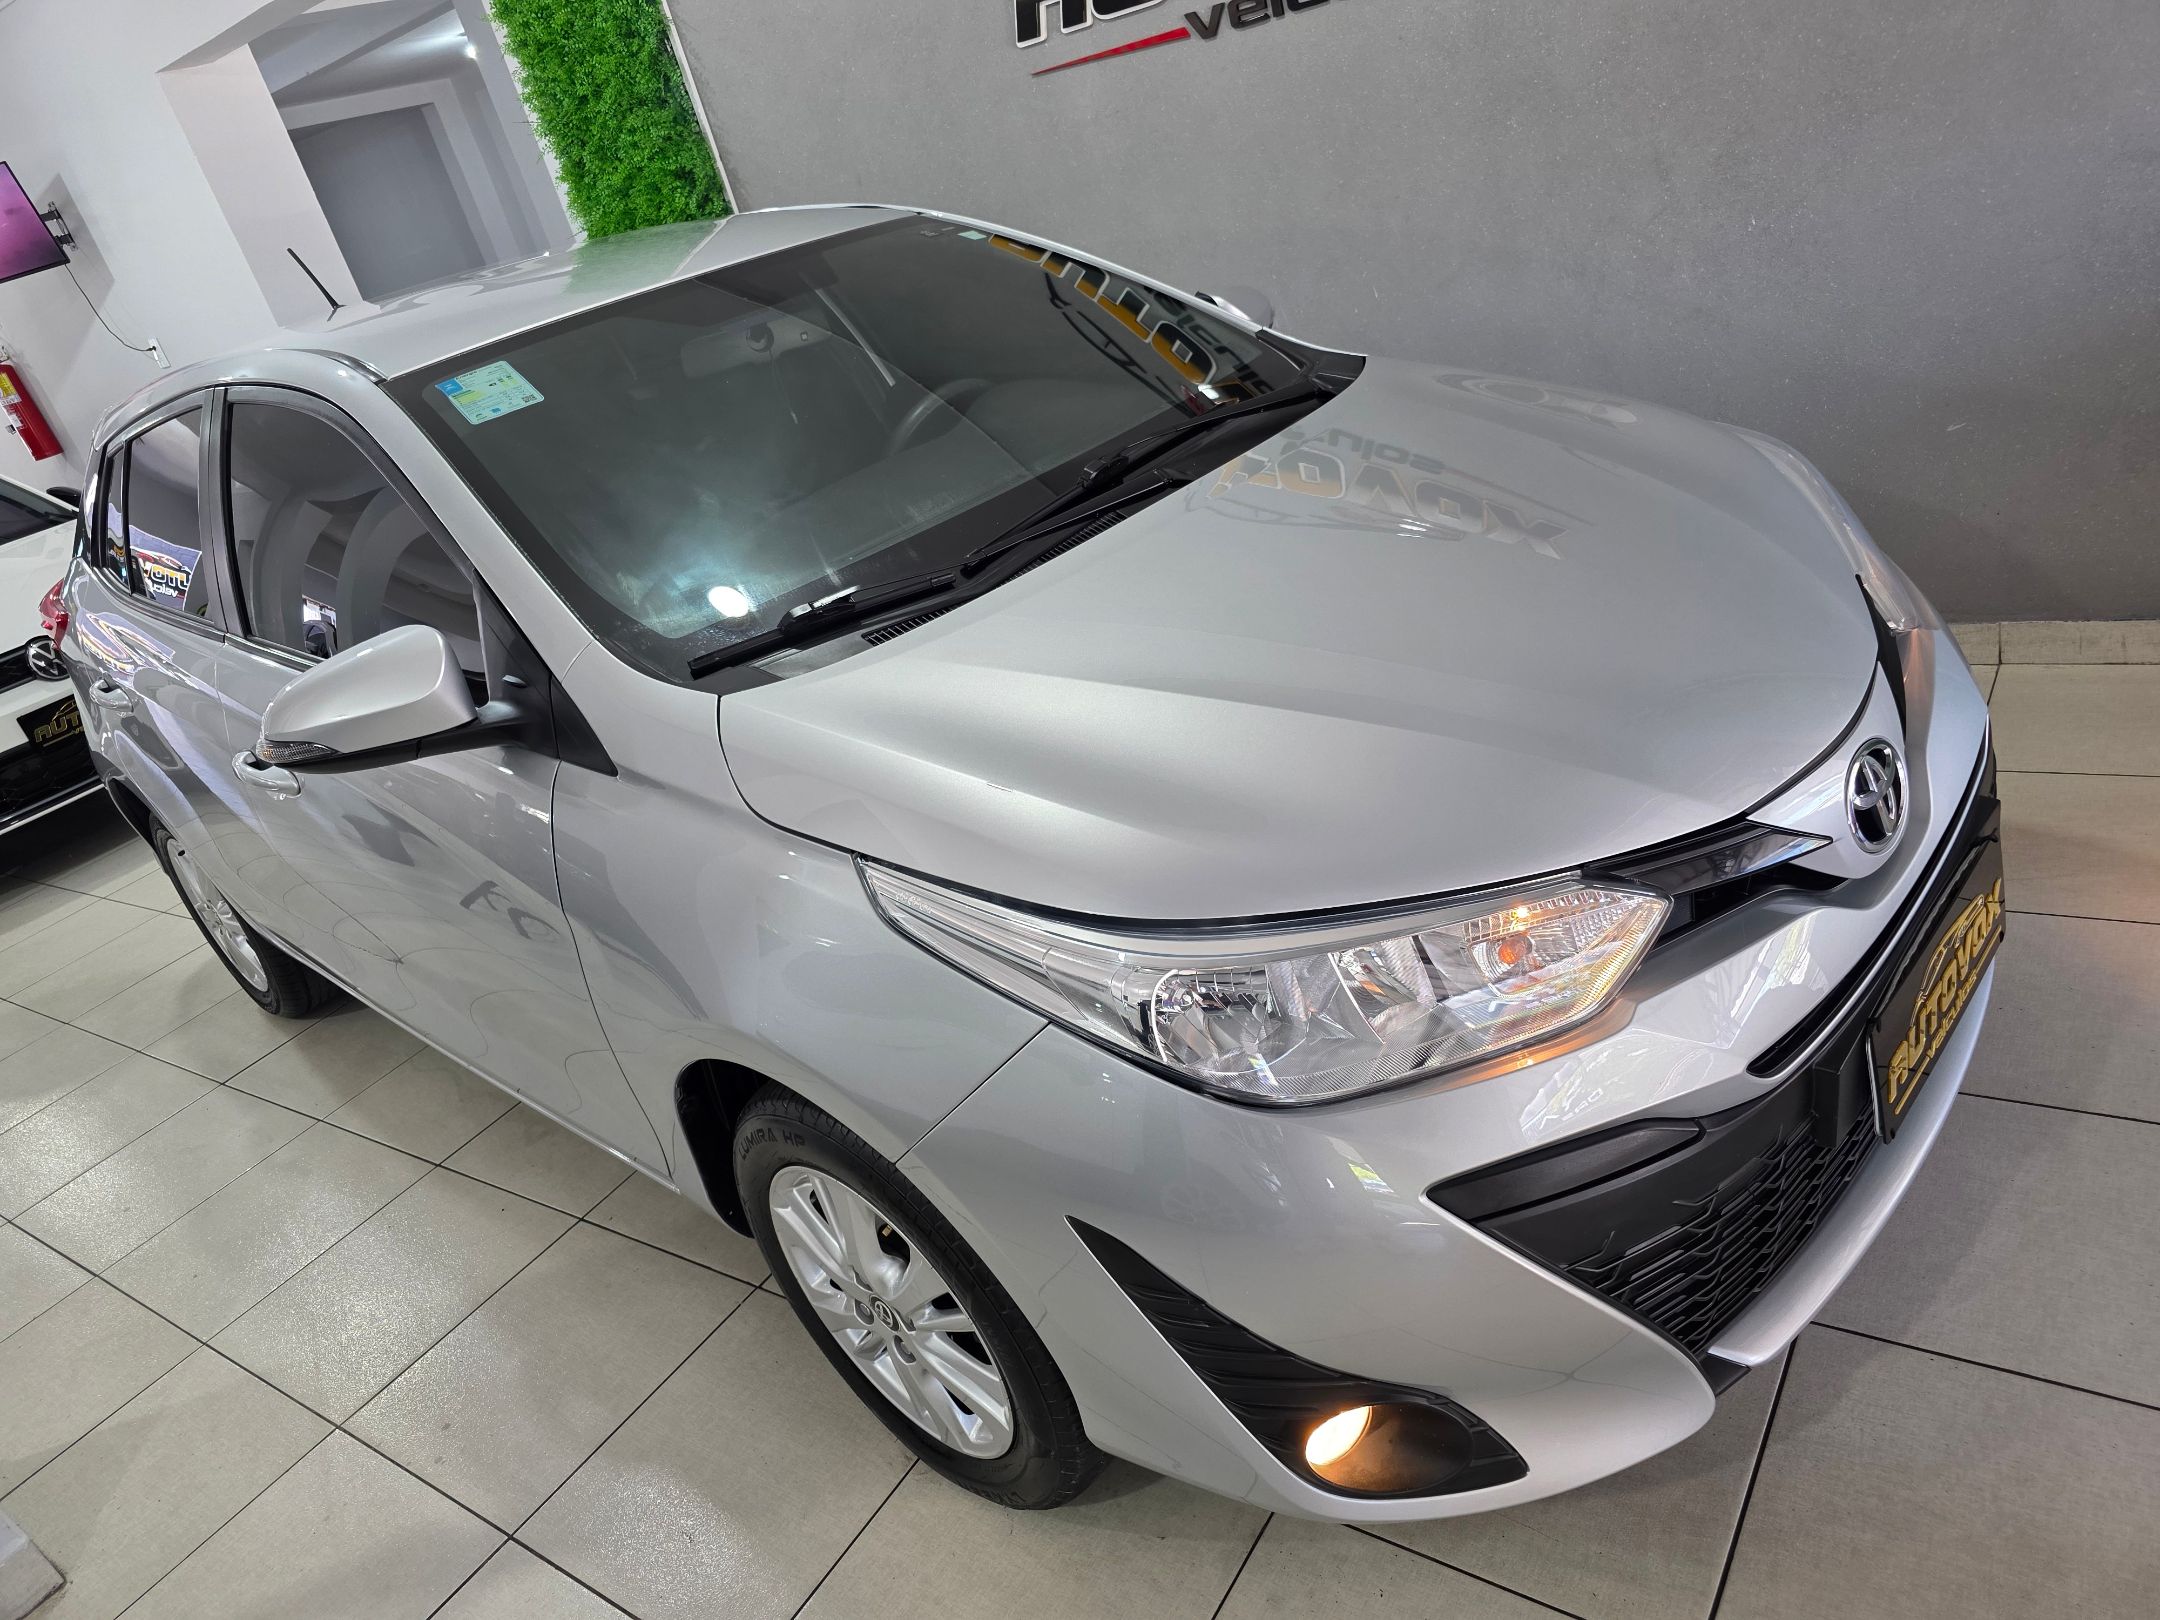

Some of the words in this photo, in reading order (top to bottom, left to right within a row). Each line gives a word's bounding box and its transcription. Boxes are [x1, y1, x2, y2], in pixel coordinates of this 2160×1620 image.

[1887, 877, 2002, 1103] AUTOVOX
[738, 1127, 778, 1160] LUMIRA
[782, 1129, 806, 1148] HP
